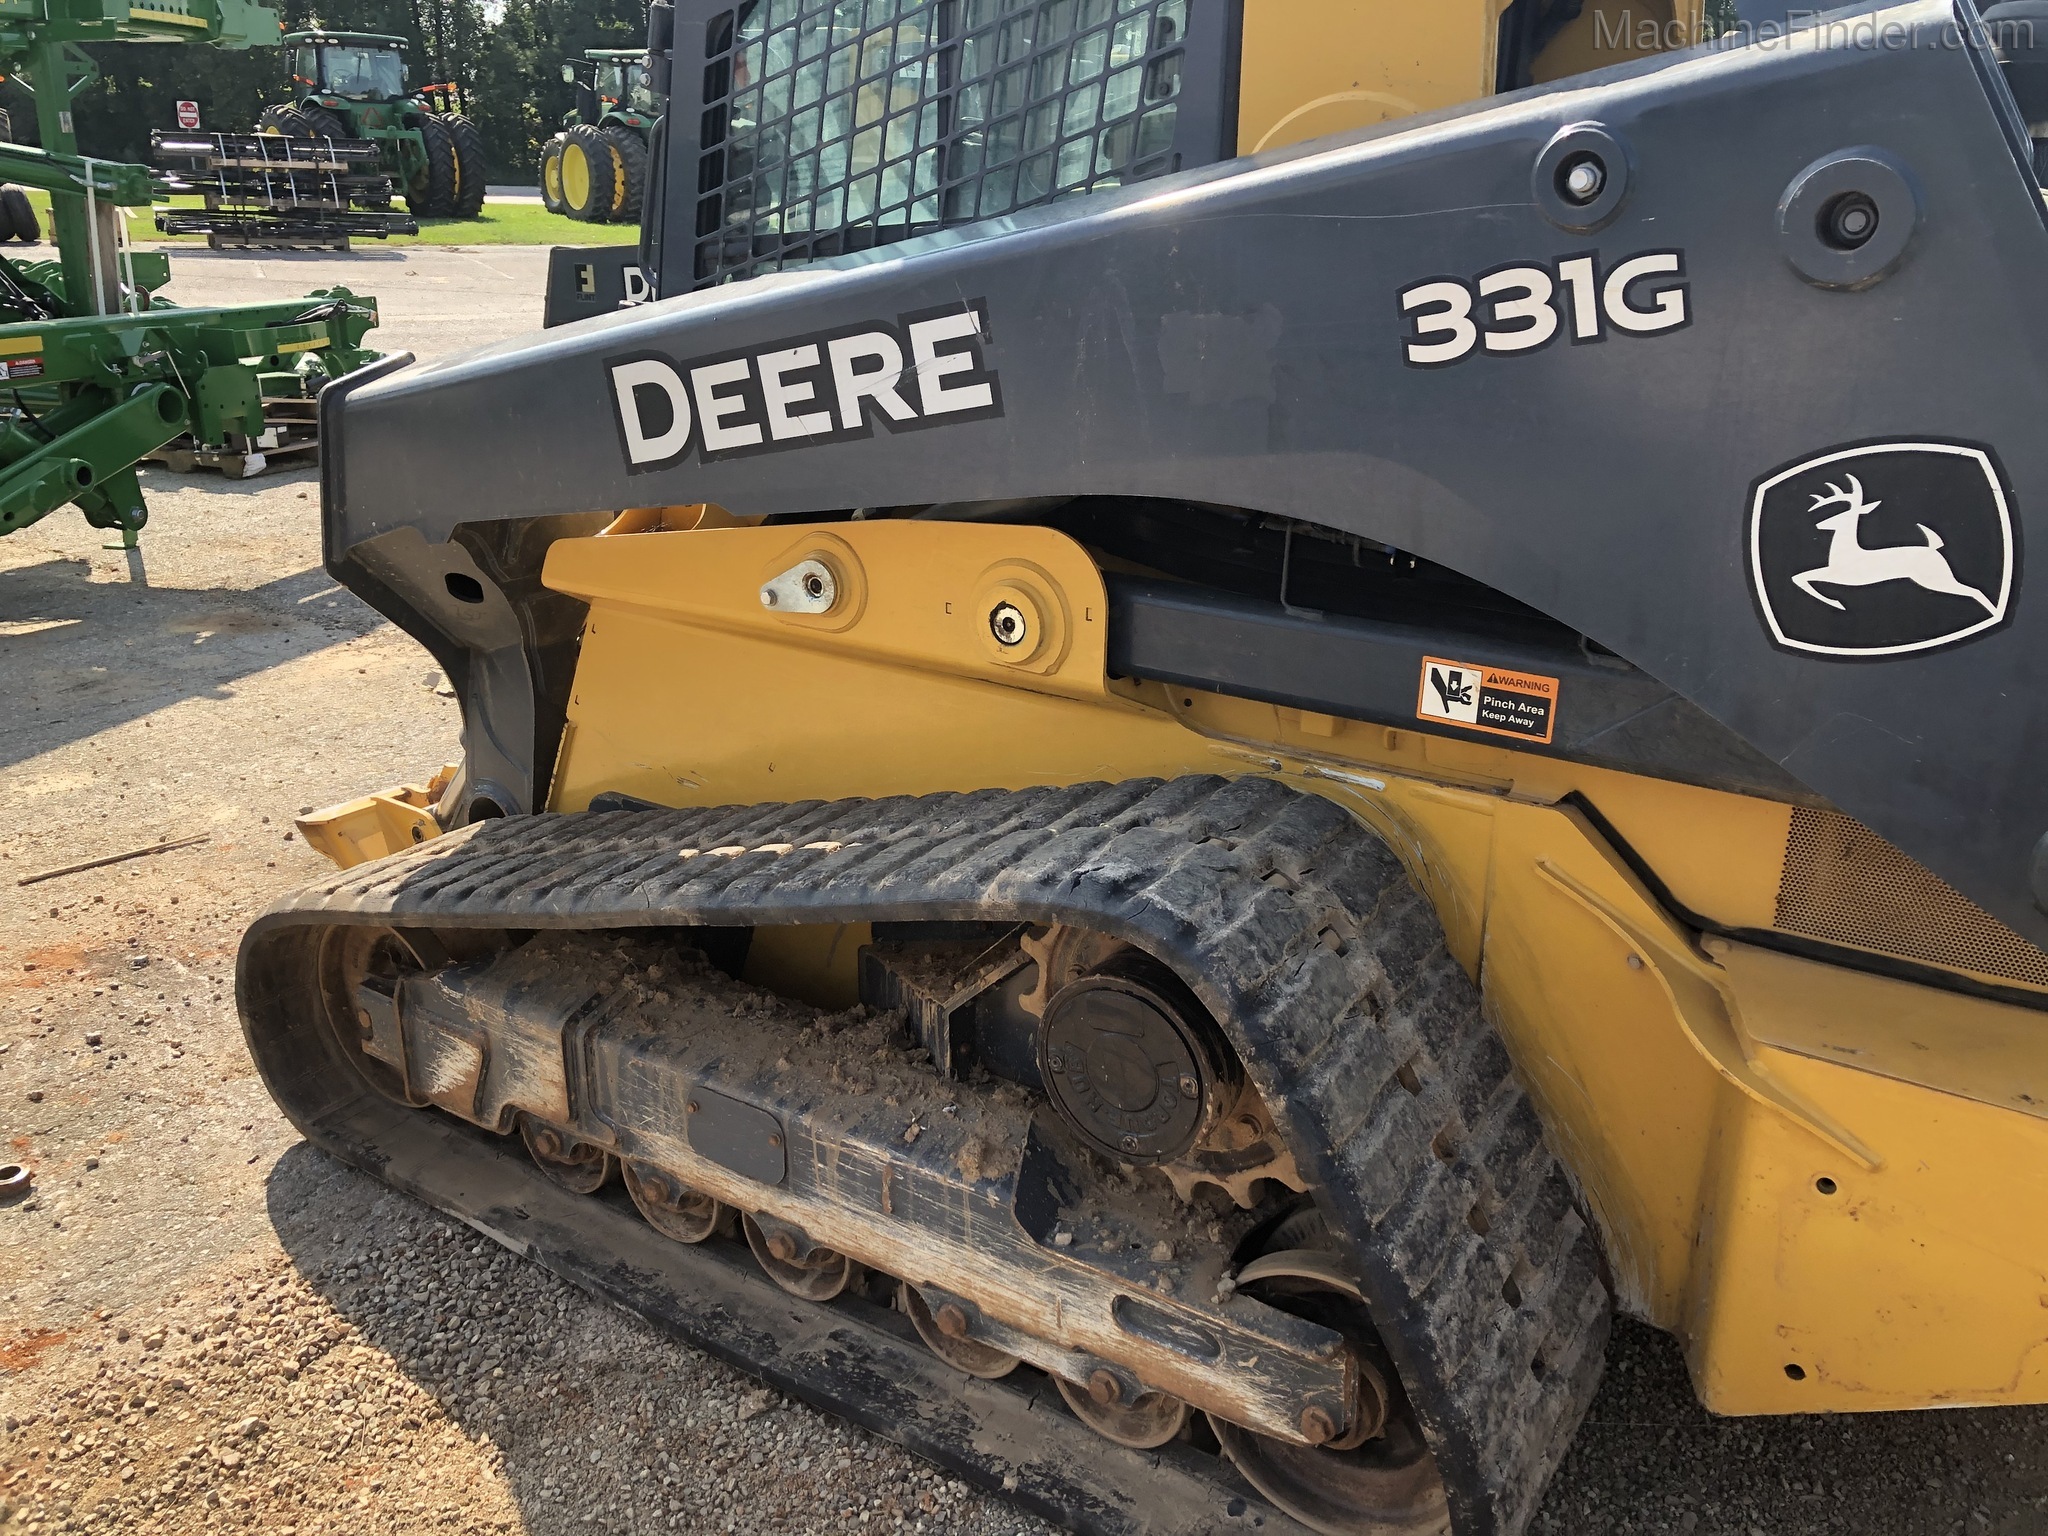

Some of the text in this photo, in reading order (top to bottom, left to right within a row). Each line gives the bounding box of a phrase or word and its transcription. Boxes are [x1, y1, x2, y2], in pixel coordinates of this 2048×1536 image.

[623, 266, 656, 301] D
[1402, 254, 1685, 363] 331G
[611, 310, 993, 464] DEERE
[1499, 676, 1550, 692] WARNING
[1482, 709, 1535, 728] Keep Away
[1483, 695, 1545, 716] Pinch Area
